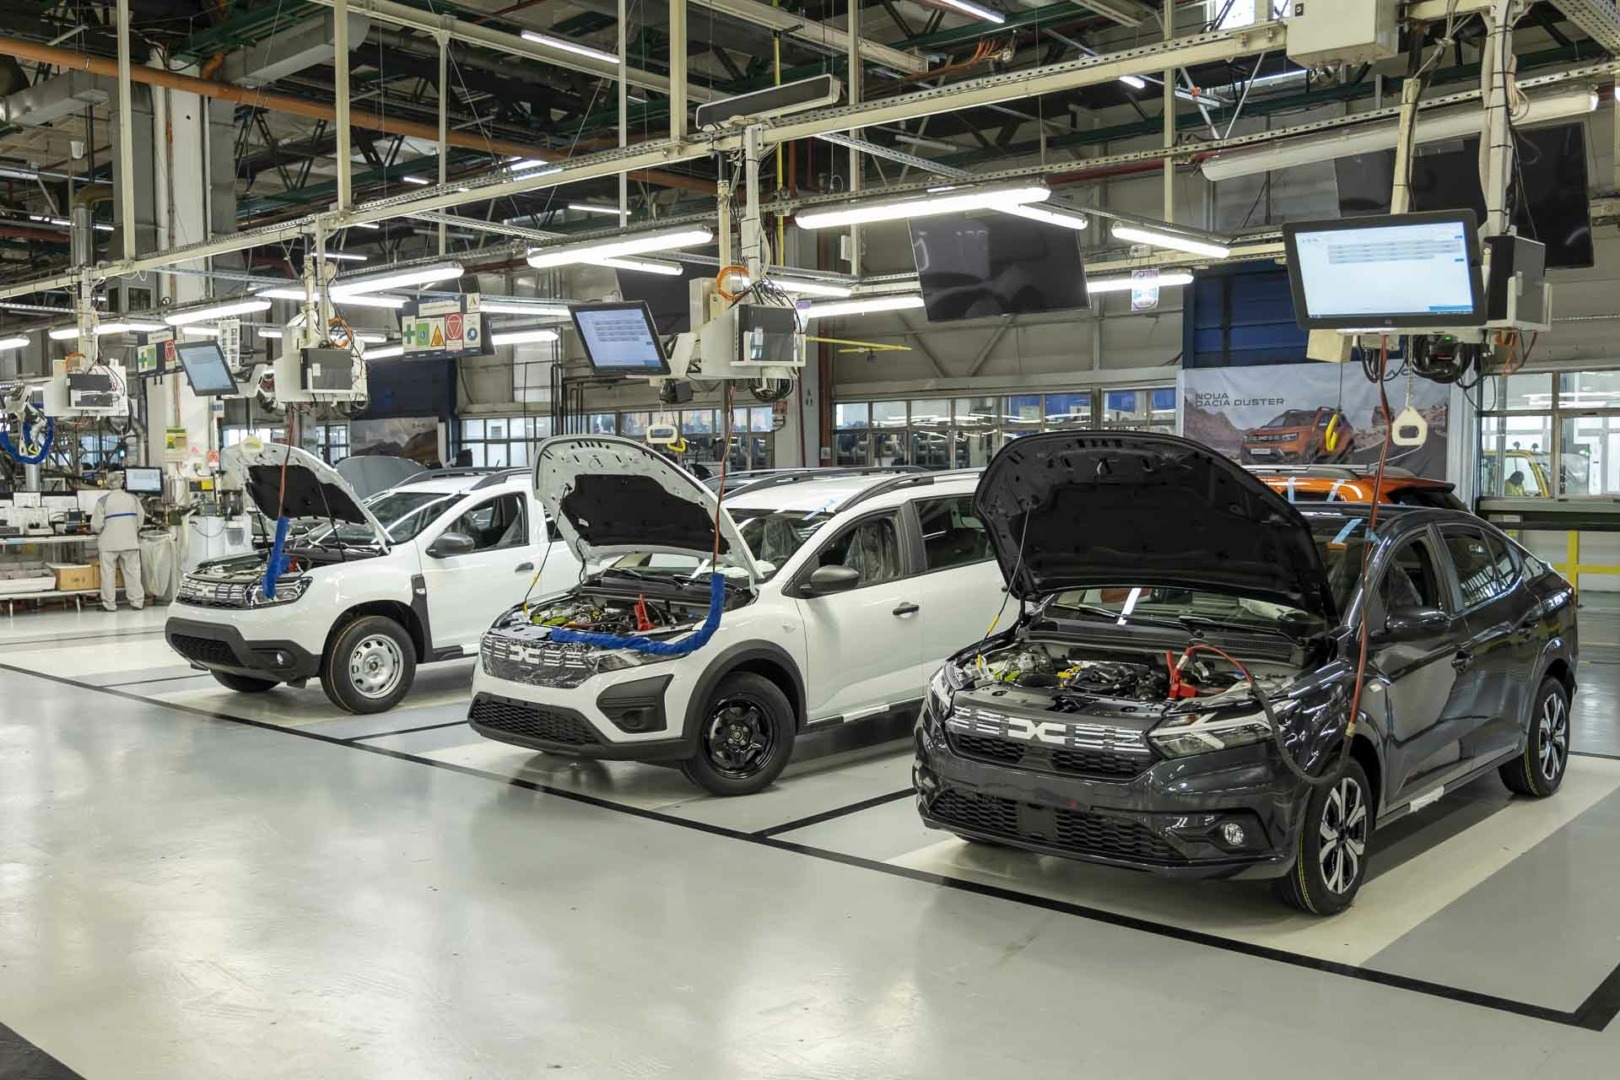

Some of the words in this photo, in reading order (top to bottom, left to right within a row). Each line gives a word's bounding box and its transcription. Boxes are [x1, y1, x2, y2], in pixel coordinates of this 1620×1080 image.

[1195, 392, 1229, 400] NOUA
[1195, 399, 1231, 407] DACIA
[1234, 398, 1285, 406] DUSTER
